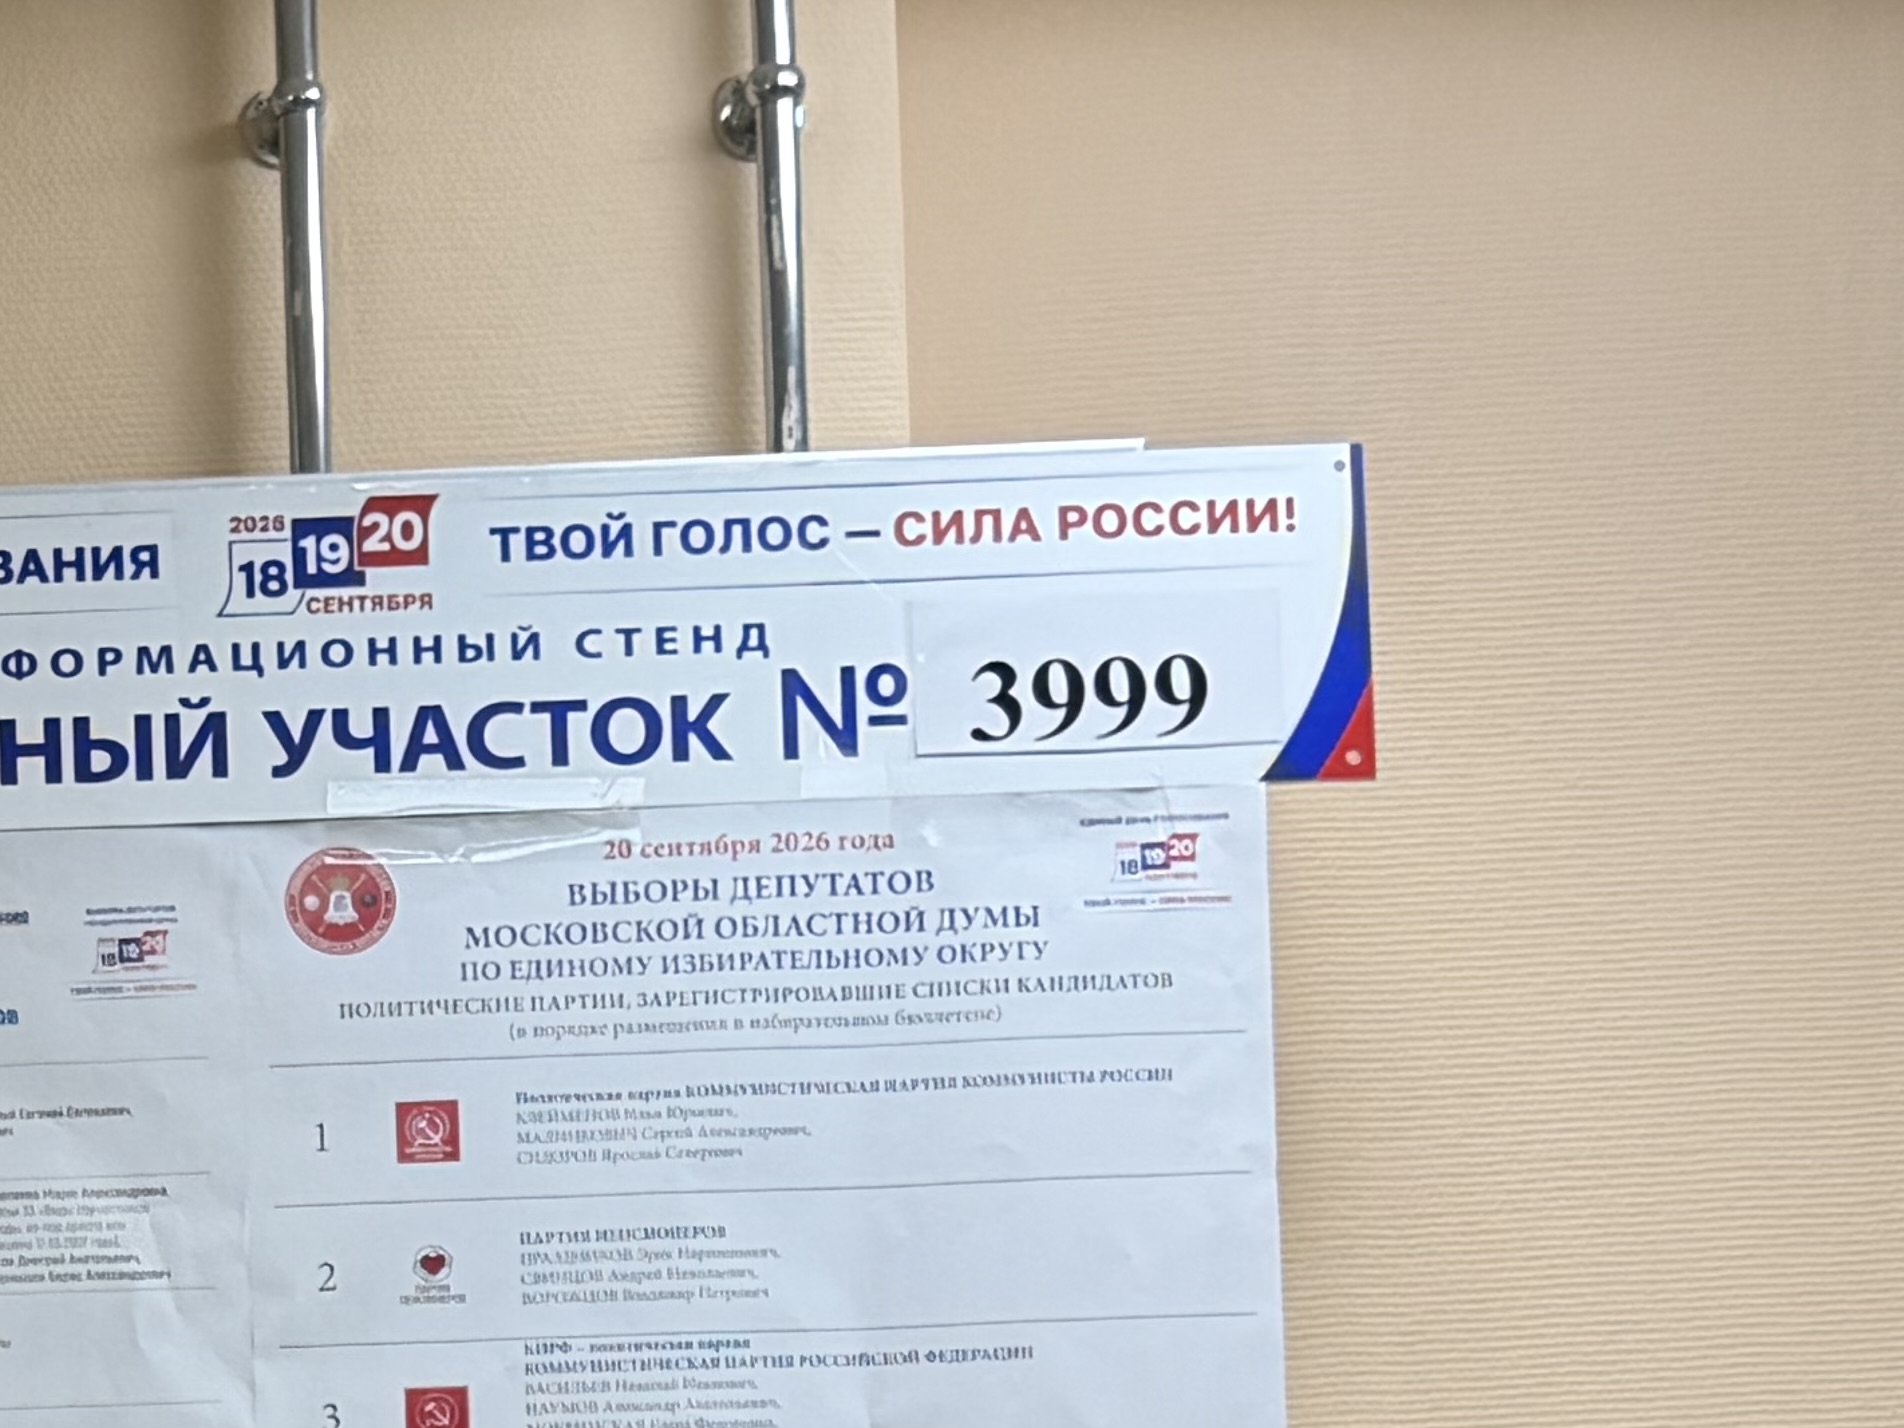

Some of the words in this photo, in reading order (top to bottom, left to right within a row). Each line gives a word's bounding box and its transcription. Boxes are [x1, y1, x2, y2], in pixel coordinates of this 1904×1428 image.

[229, 515, 285, 533] 2026
[488, 511, 634, 563] ТВОЙ
[652, 514, 830, 557] ГОЛОС
[894, 507, 1041, 547] СИЛА
[1058, 496, 1296, 541] РОССИИ!
[238, 559, 288, 599] 18
[298, 533, 350, 574] 19
[361, 511, 423, 552] 20
[305, 593, 433, 614] СЕНТЯБРЯ
[575, 622, 770, 660] СТЕНД
[268, 692, 735, 772] УЧАСТОК
[777, 663, 908, 760] №
[968, 654, 1210, 746] 3999
[601, 838, 633, 861] 20
[639, 833, 761, 862] сентября
[770, 830, 831, 854] 2026
[838, 833, 895, 852] года
[567, 878, 719, 907] ВЫБОРЫ
[730, 869, 935, 905] ДЕПУТАТОВ
[465, 913, 705, 950] МОСКОВСКОЙ
[714, 906, 926, 940] ОБЛАСТНОЙ
[935, 905, 1040, 937] ДУМЫ
[460, 961, 502, 982] ПО
[509, 956, 652, 982] ЕДИНОМУ
[661, 945, 929, 975] ИЗБИРАТЕЛЬНОМУ
[936, 940, 1048, 965] ОКРУГУ
[339, 996, 524, 1020] ПОЛИТИЧЕСКИЕ
[530, 992, 631, 1013] ПАРТИИ,
[637, 983, 906, 1008] ЗАРЕГИСТРИРОВАВШИЕ
[911, 977, 1010, 998] СПИСКИ
[1017, 972, 1173, 993] КАНДИДАТОВ
[317, 1123, 327, 1151] 1
[319, 1262, 336, 1292] 2
